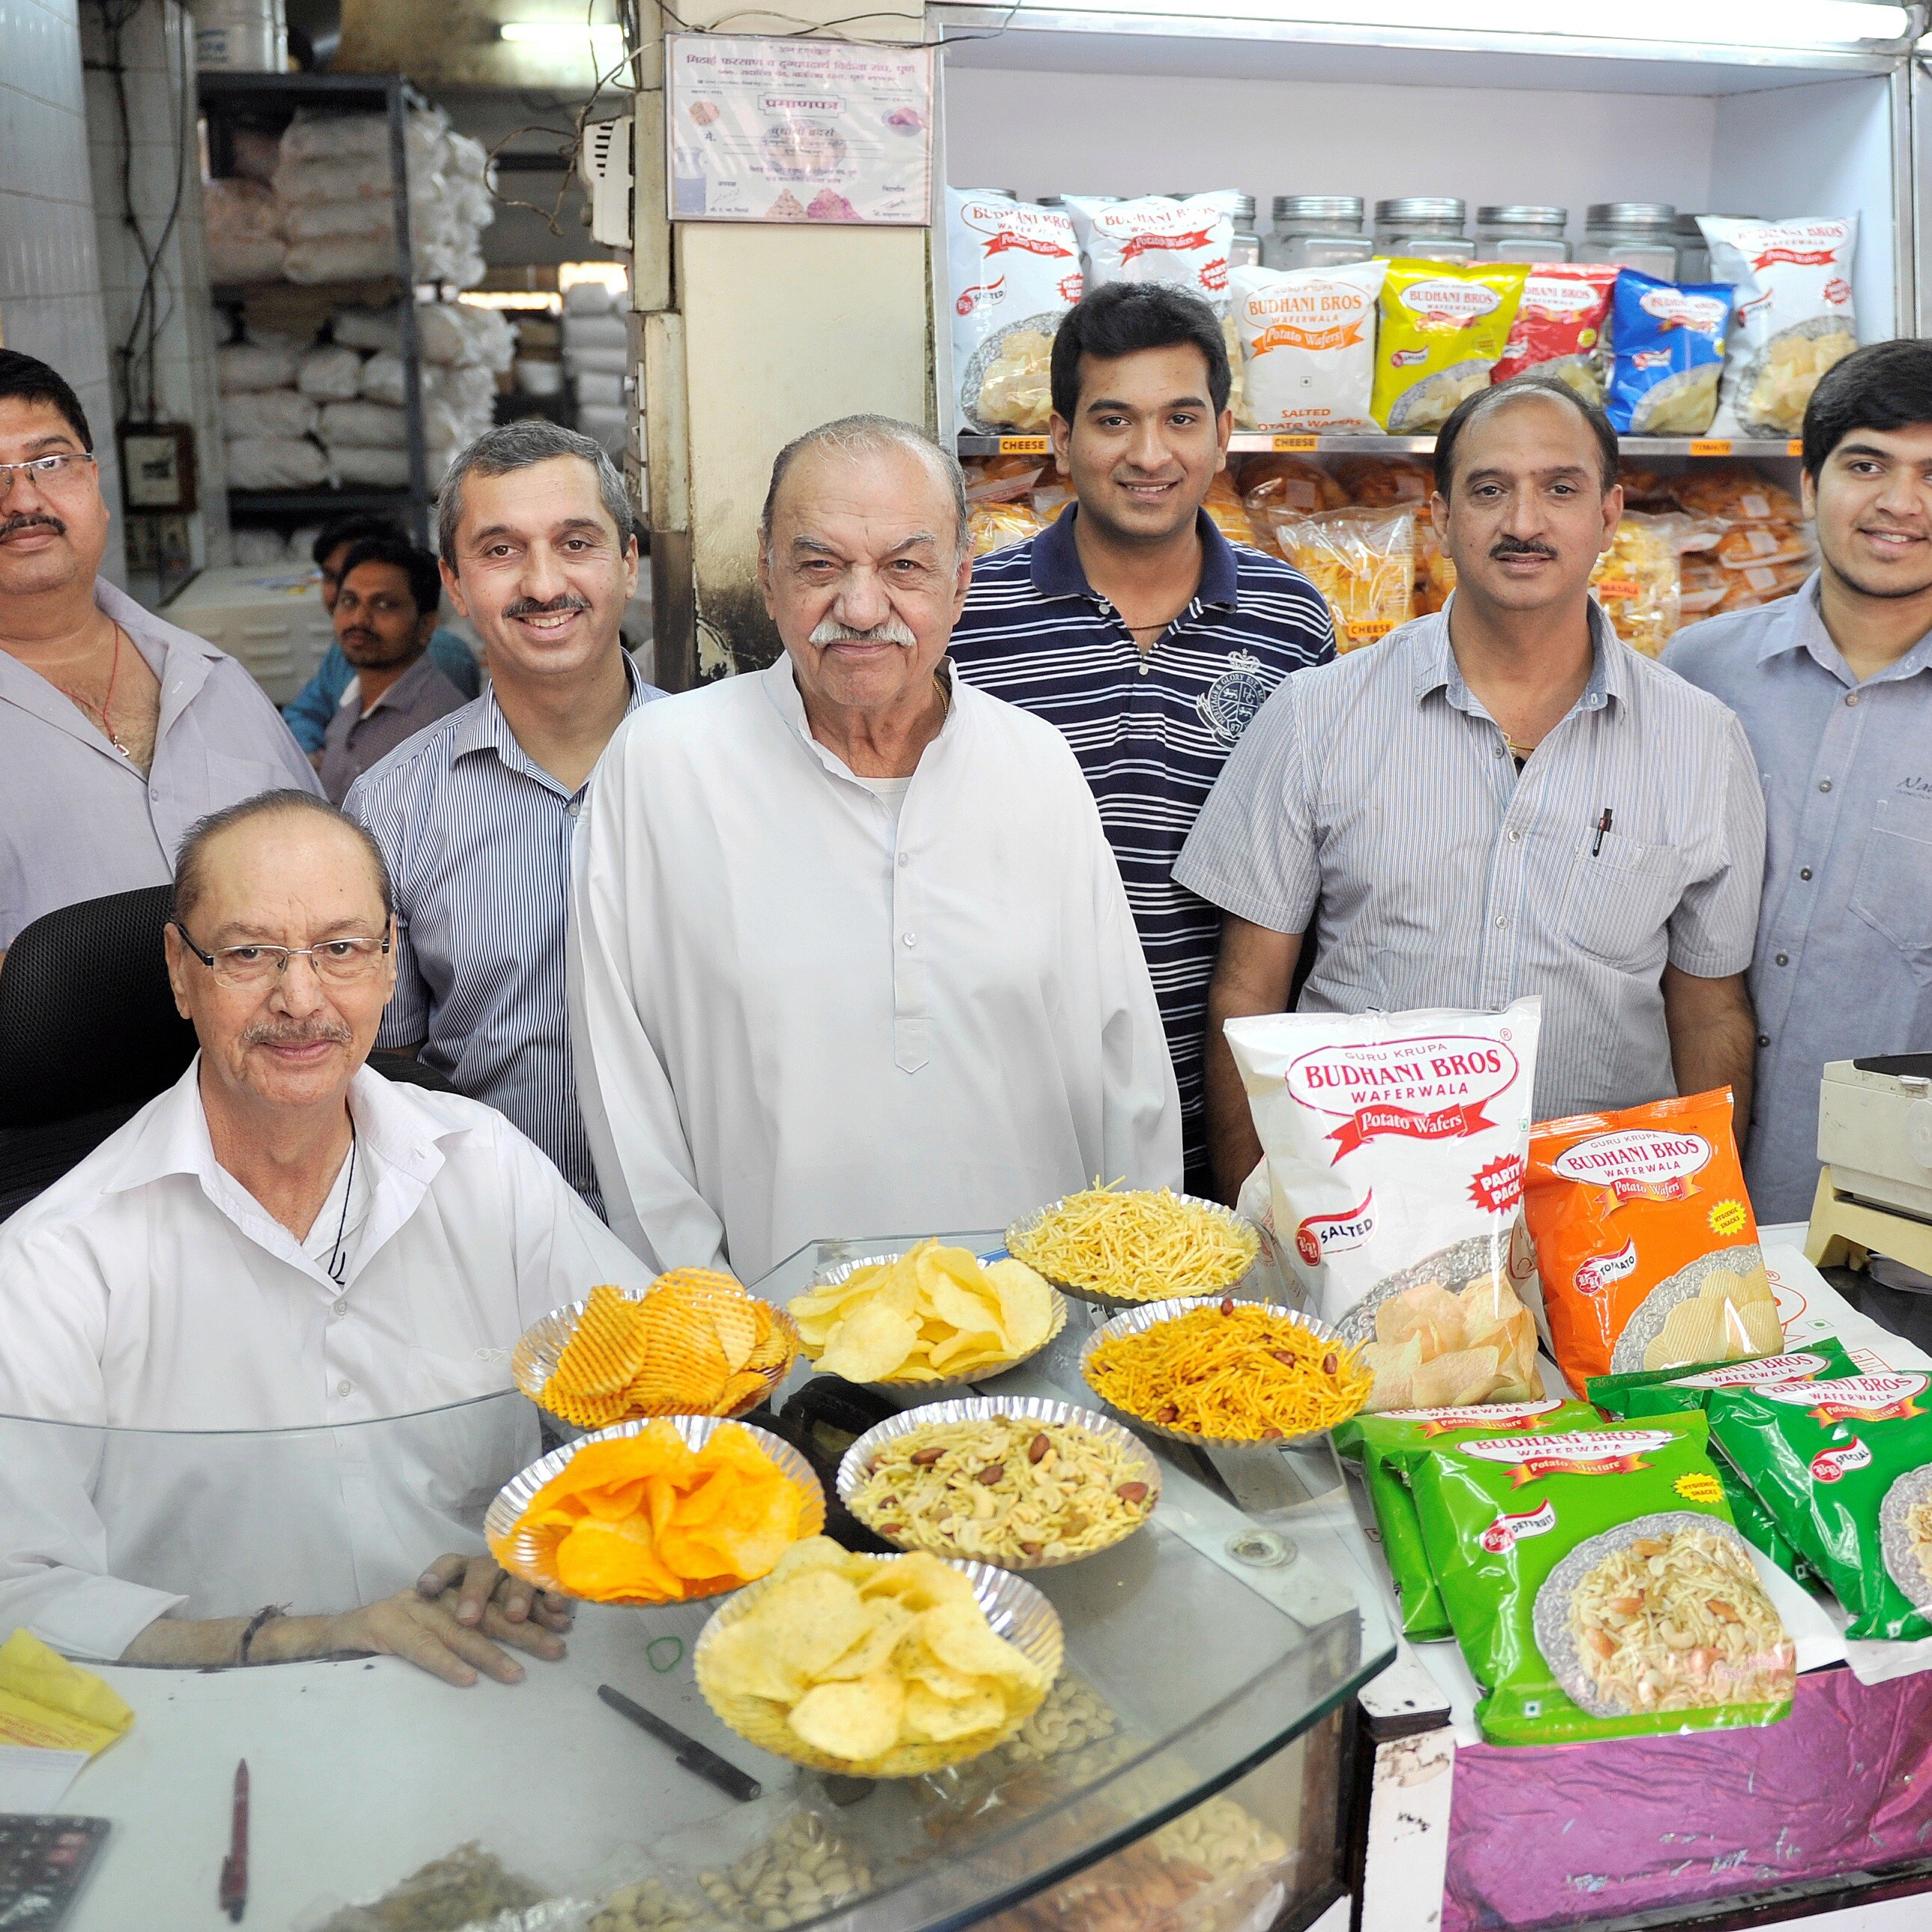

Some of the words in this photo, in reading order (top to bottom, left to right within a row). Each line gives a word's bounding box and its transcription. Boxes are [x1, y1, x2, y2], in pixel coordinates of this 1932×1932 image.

[1249, 297, 1316, 315] BUDHANI
[1320, 294, 1364, 311] BROS
[1409, 290, 1460, 303] BUDHANI
[1463, 292, 1492, 304] BROS
[1272, 315, 1340, 324] WAFERWALA
[1267, 327, 1301, 342] Potato
[1304, 330, 1343, 348] Wafers
[1281, 408, 1331, 419] SALTED
[1001, 440, 1045, 450] CHEESE
[1275, 437, 1315, 447] CHEESE
[1351, 624, 1391, 634] CHEESE
[1210, 688, 1226, 725] HERITAGE
[1221, 674, 1245, 685] GLORY
[1344, 1051, 1388, 1062] GURU
[1393, 1042, 1448, 1059] KRUPA
[1304, 1062, 1426, 1089] BUDHANI
[1429, 1049, 1501, 1078] BROS
[1350, 1081, 1469, 1105] WAFERWALA
[1361, 1111, 1411, 1131] Potato
[1412, 1113, 1463, 1134] Wafers
[1590, 1137, 1622, 1149] GURU
[1623, 1132, 1660, 1143] KRUPA
[1567, 1145, 1649, 1170] BUDHANI
[1650, 1138, 1700, 1159] BROS
[1480, 1162, 1521, 1192] PARTY
[1603, 1160, 1681, 1178] WAFERWALA
[1490, 1178, 1521, 1206] PACK
[1613, 1179, 1647, 1197] Potato
[1649, 1179, 1680, 1199] Wafers
[1320, 1218, 1373, 1245] SALTED
[1600, 1255, 1635, 1276] TOMATO
[1761, 1354, 1814, 1369] BROS
[1710, 1367, 1796, 1383] WAFERWALA
[1858, 1376, 1913, 1392] BROS
[1809, 1392, 1895, 1403] WAFERWALA
[1427, 1406, 1524, 1417] WAFERWALA
[1826, 1405, 1858, 1417] Potato
[1861, 1404, 1901, 1420] Mixture
[1440, 1418, 1475, 1427] Potato
[1479, 1418, 1522, 1428] Mixture
[1475, 1433, 1582, 1450] BUDHANI
[1516, 1443, 1623, 1457] WAFERWALA
[1530, 1460, 1569, 1472] Potato
[1573, 1460, 1620, 1473] Mixture
[1512, 1514, 1553, 1534] DRYFRUIT
